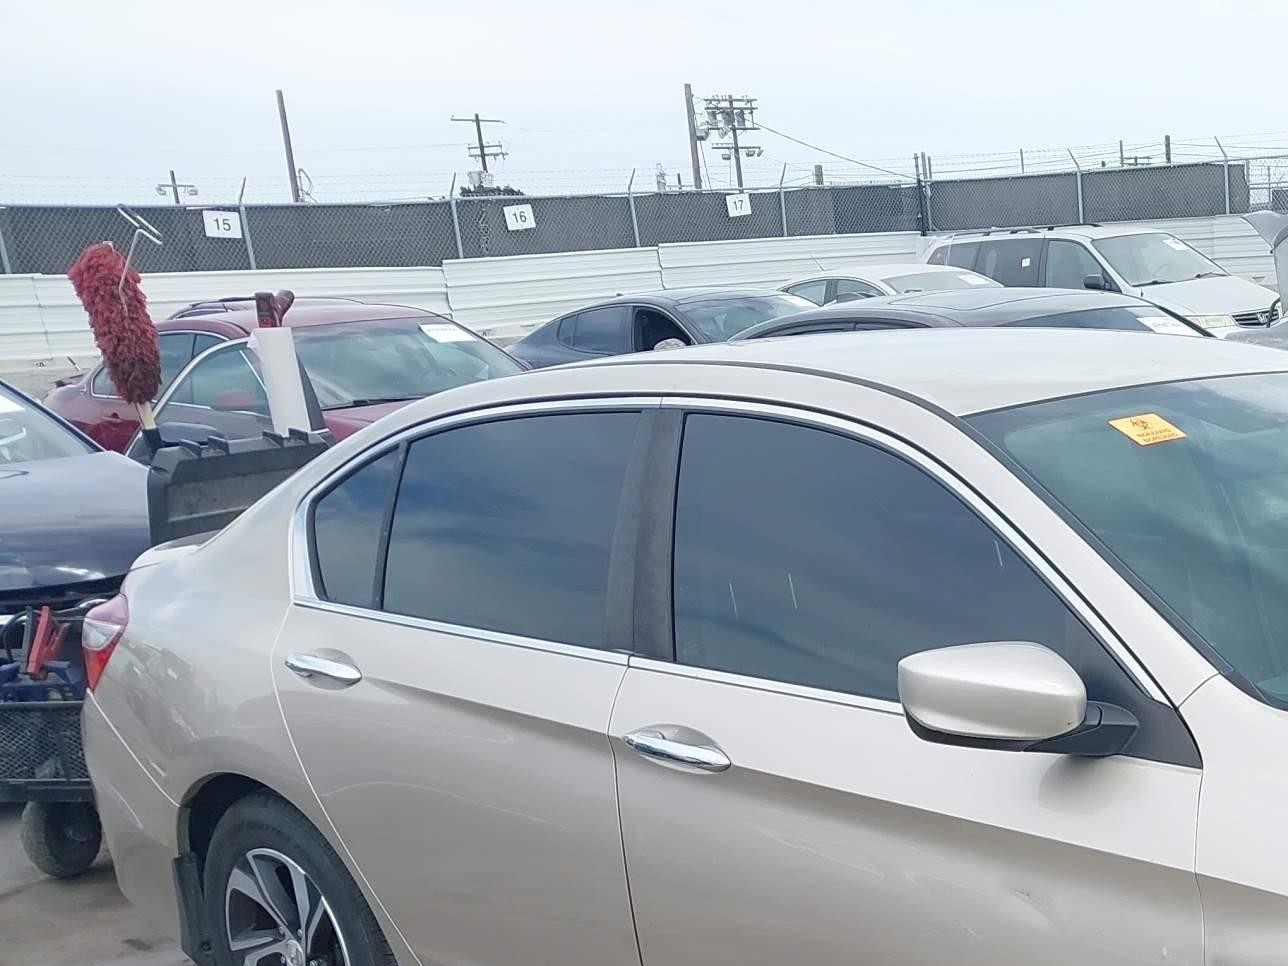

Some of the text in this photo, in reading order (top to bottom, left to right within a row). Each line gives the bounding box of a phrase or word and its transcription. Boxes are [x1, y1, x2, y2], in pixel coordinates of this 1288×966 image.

[733, 199, 744, 211] 17
[511, 210, 527, 224] 16
[213, 218, 232, 231] 15
